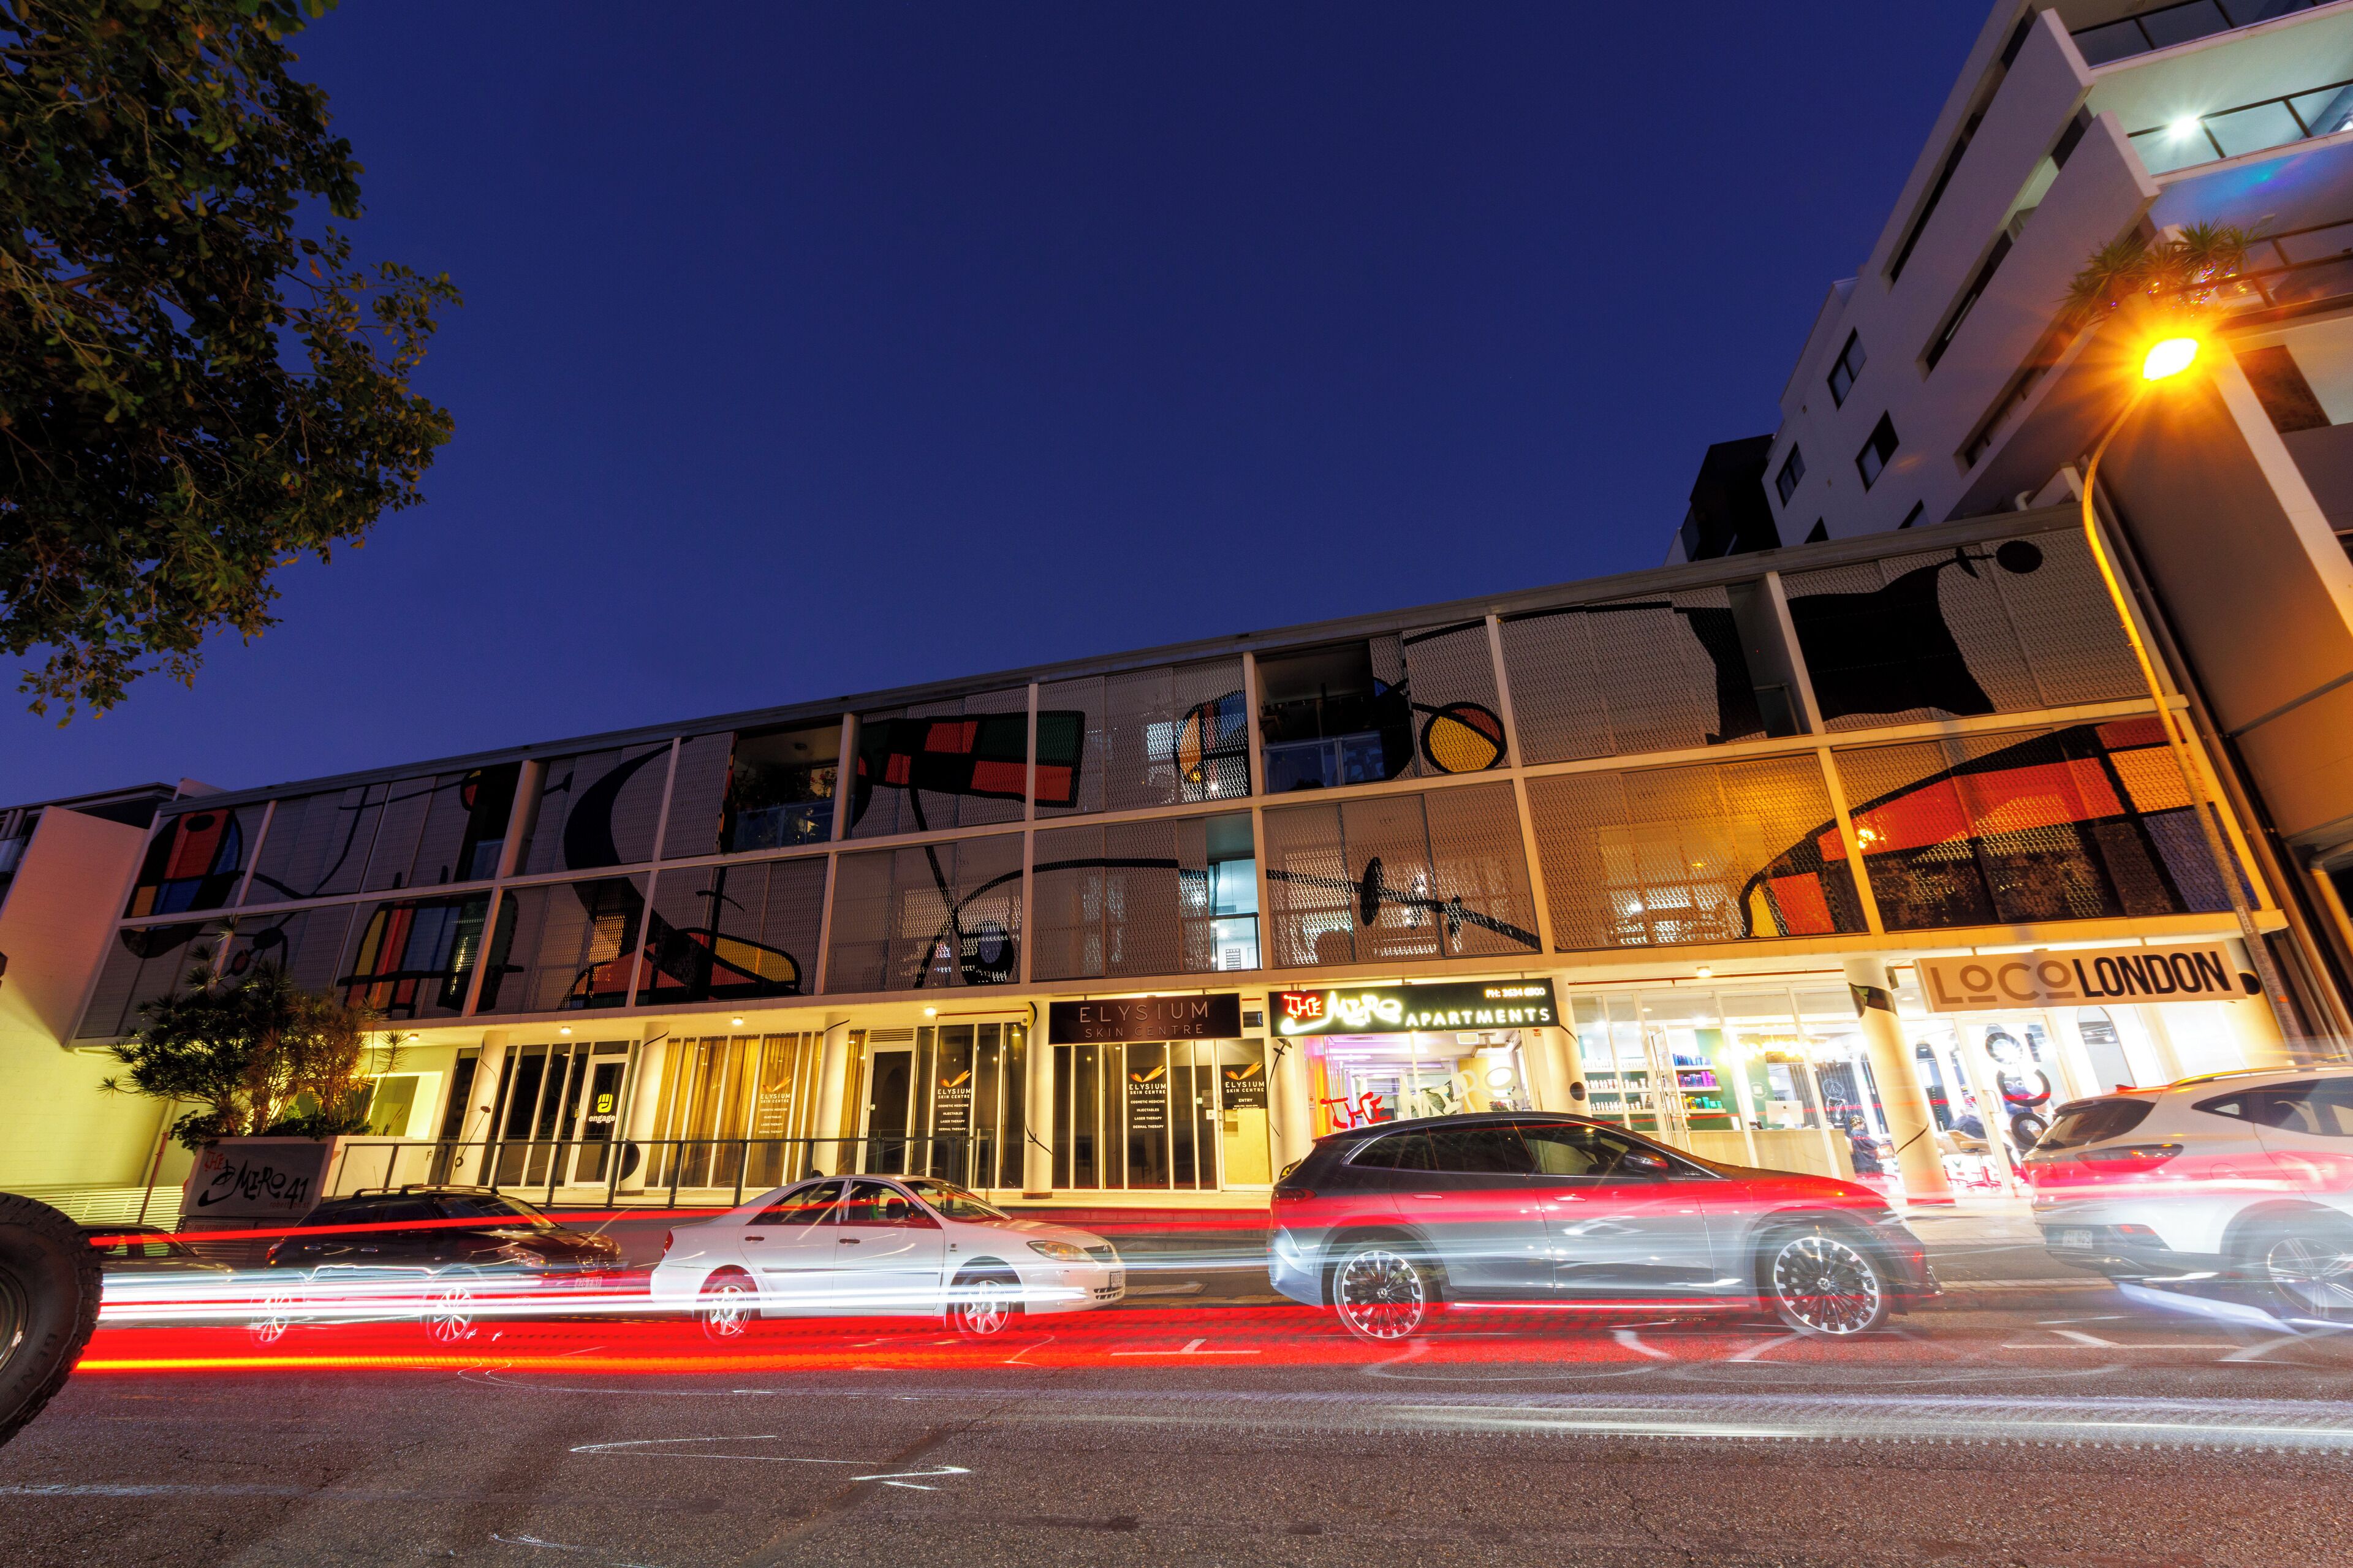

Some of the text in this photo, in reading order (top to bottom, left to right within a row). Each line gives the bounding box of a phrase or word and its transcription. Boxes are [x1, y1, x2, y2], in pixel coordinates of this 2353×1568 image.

[1930, 951, 2233, 1005] LOCO LONDON
[1079, 1000, 1209, 1023] ELYSIUM
[1283, 994, 1323, 1019] THE
[1405, 1007, 1551, 1027] APARTMENTS
[1085, 1023, 1203, 1039] SKIN CENTRE
[588, 1115, 616, 1124] engage
[1319, 1091, 1392, 1129] THE
[204, 1149, 224, 1172] THE
[283, 1178, 309, 1210] 41
